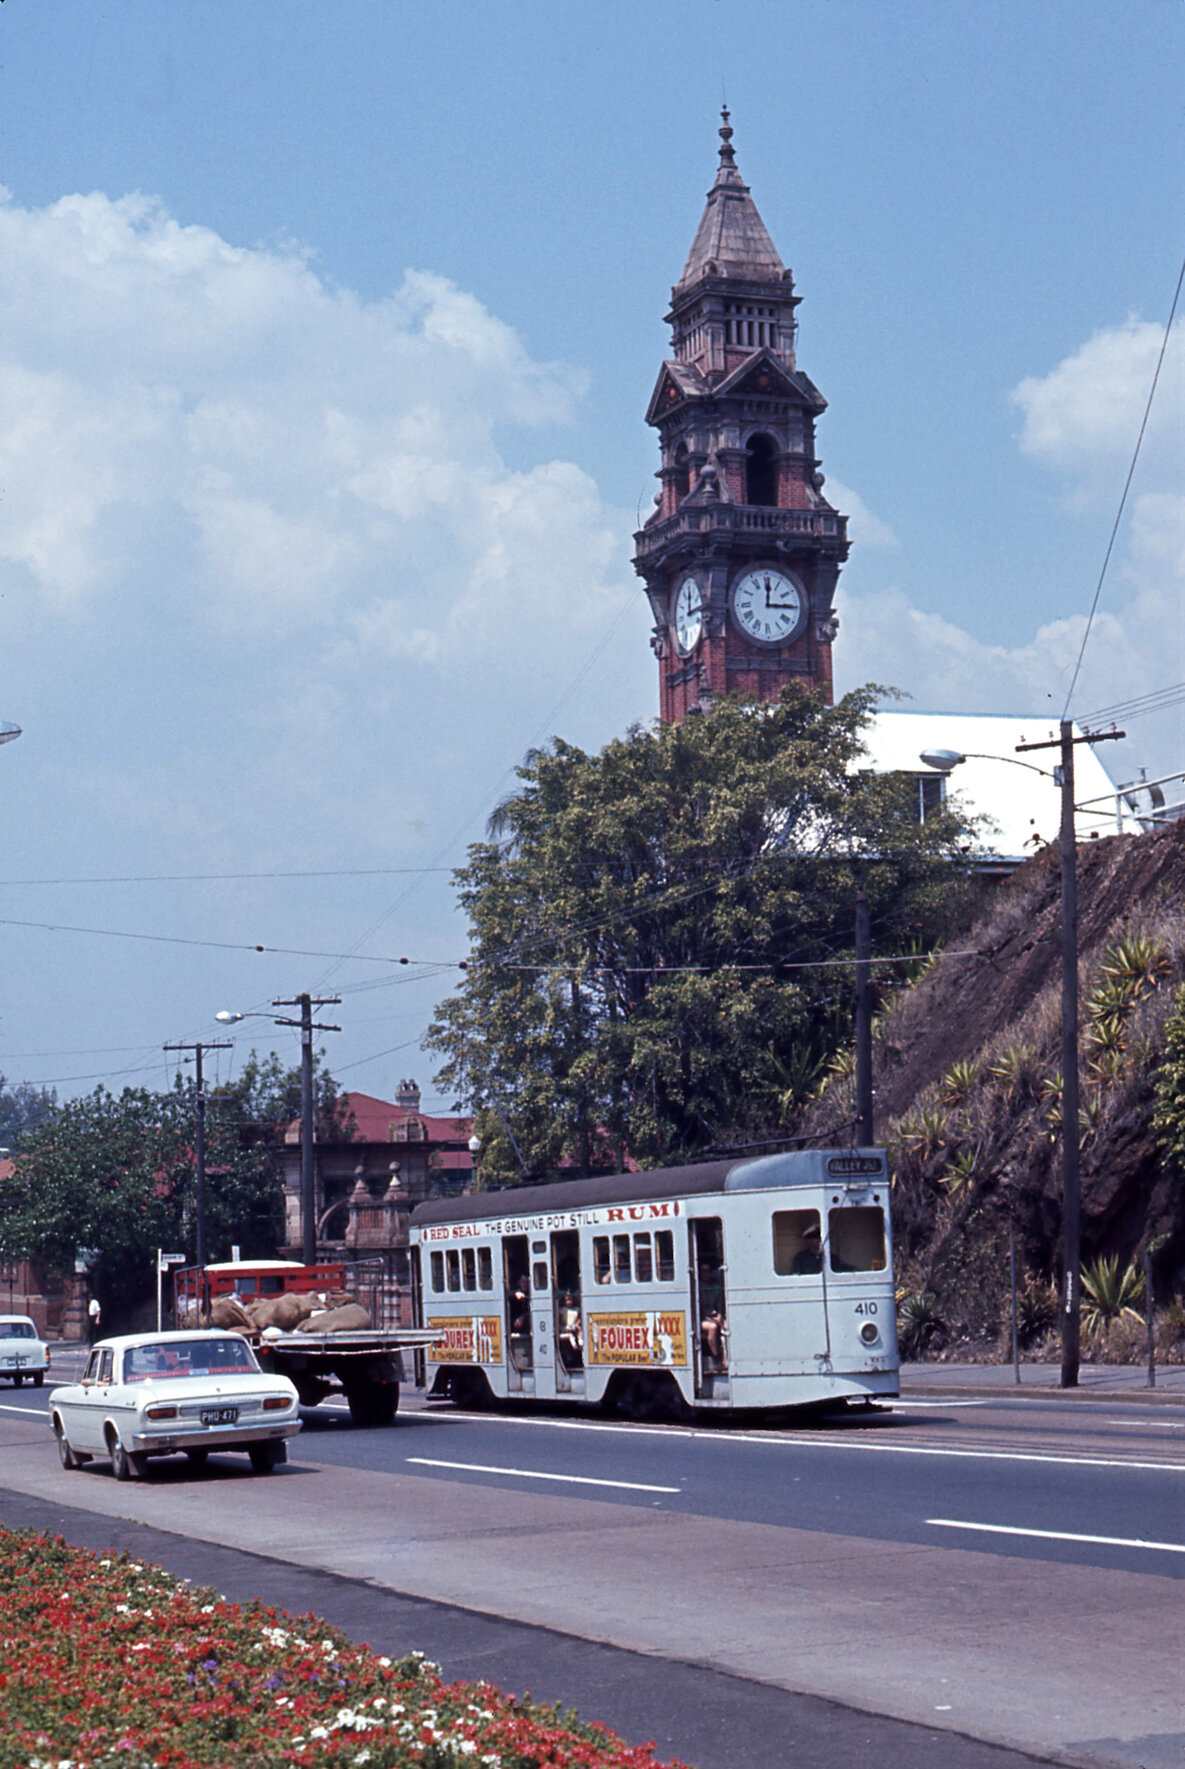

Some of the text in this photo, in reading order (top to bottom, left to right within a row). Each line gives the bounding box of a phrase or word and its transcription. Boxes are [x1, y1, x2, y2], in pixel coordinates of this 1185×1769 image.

[430, 1203, 670, 1240] RED SEAL THE GENUINE POT STILL RUM
[854, 1302, 878, 1316] 410
[658, 1317, 680, 1336] XXXX
[435, 1330, 474, 1349] OUREX
[600, 1326, 650, 1350] FOUREX
